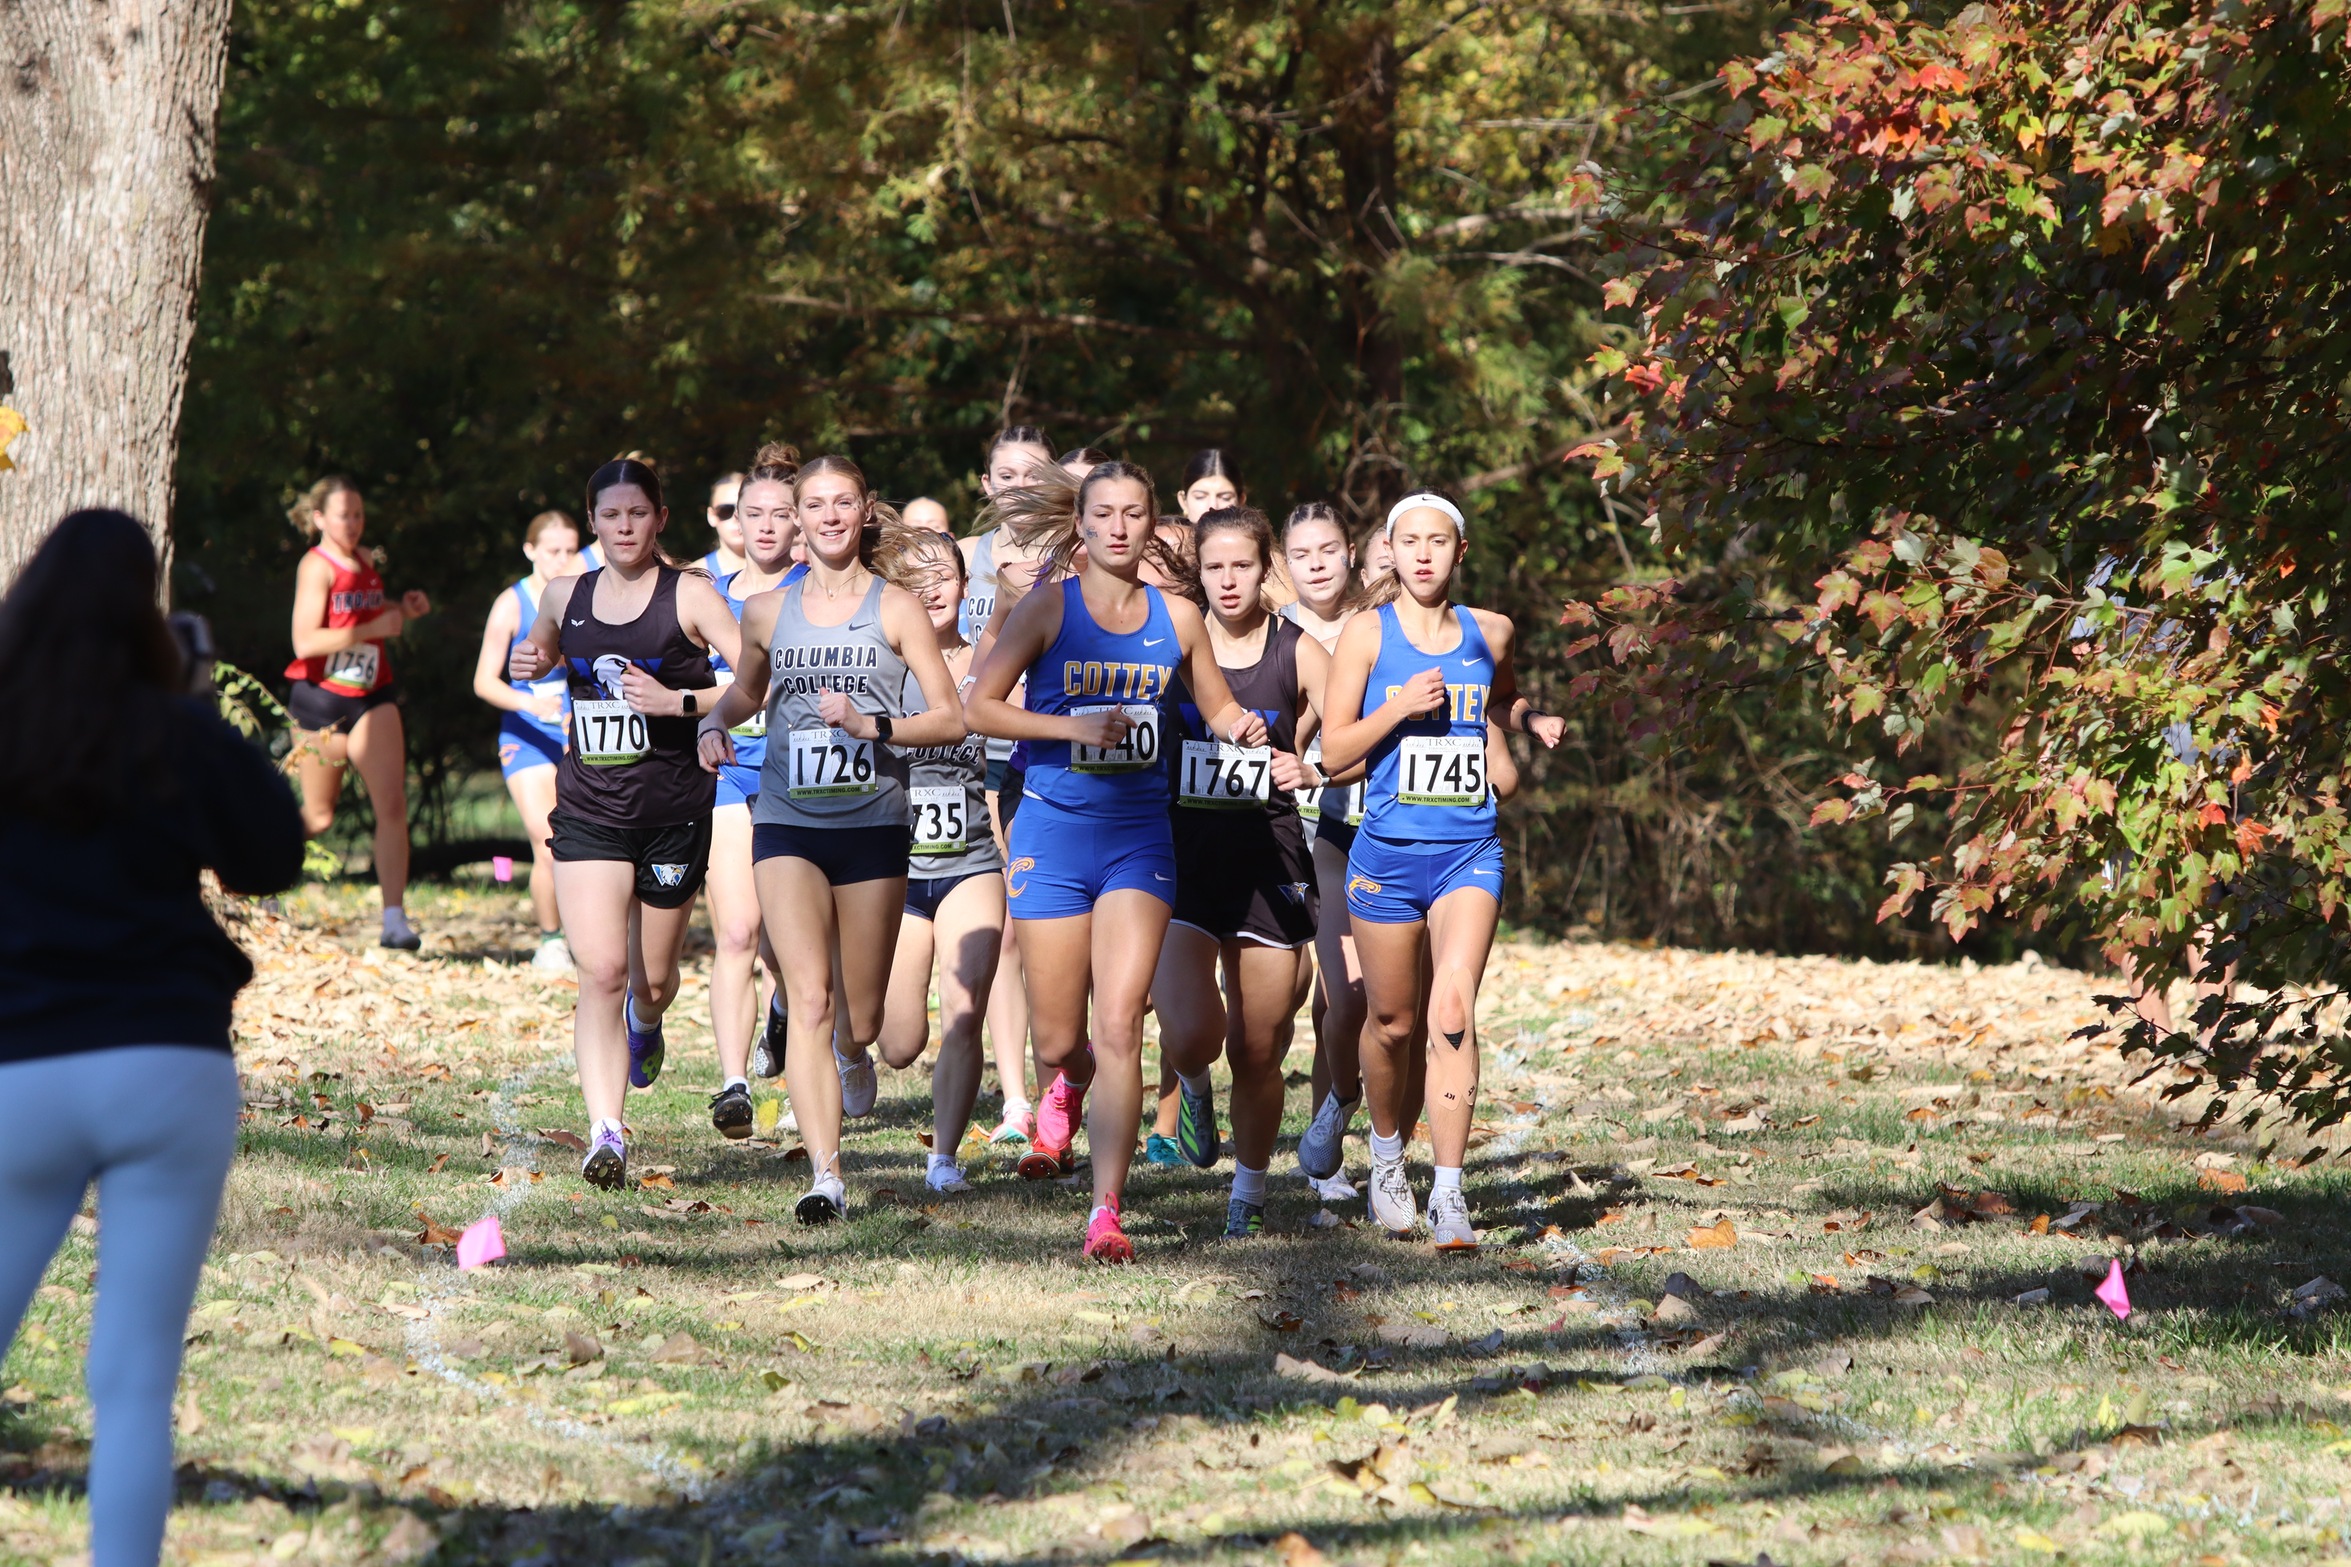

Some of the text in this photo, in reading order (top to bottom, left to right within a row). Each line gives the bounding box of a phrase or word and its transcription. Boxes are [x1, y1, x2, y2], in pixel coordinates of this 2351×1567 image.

[331, 651, 376, 680] 1756
[775, 645, 878, 671] COLUMBIA
[783, 674, 869, 695] COLLEGE
[1064, 661, 1173, 701] COTTEY
[591, 701, 620, 709] TRXC
[1386, 684, 1490, 723] TEY
[582, 714, 645, 752] 1770
[811, 729, 847, 739] TRXC
[1426, 737, 1461, 746] TRXC
[797, 742, 871, 786] 1726
[1189, 756, 1267, 797] 1767
[1408, 753, 1481, 793] 1745
[797, 787, 860, 796] WWW.TRXCTIMING.COM
[911, 803, 962, 840] 735
